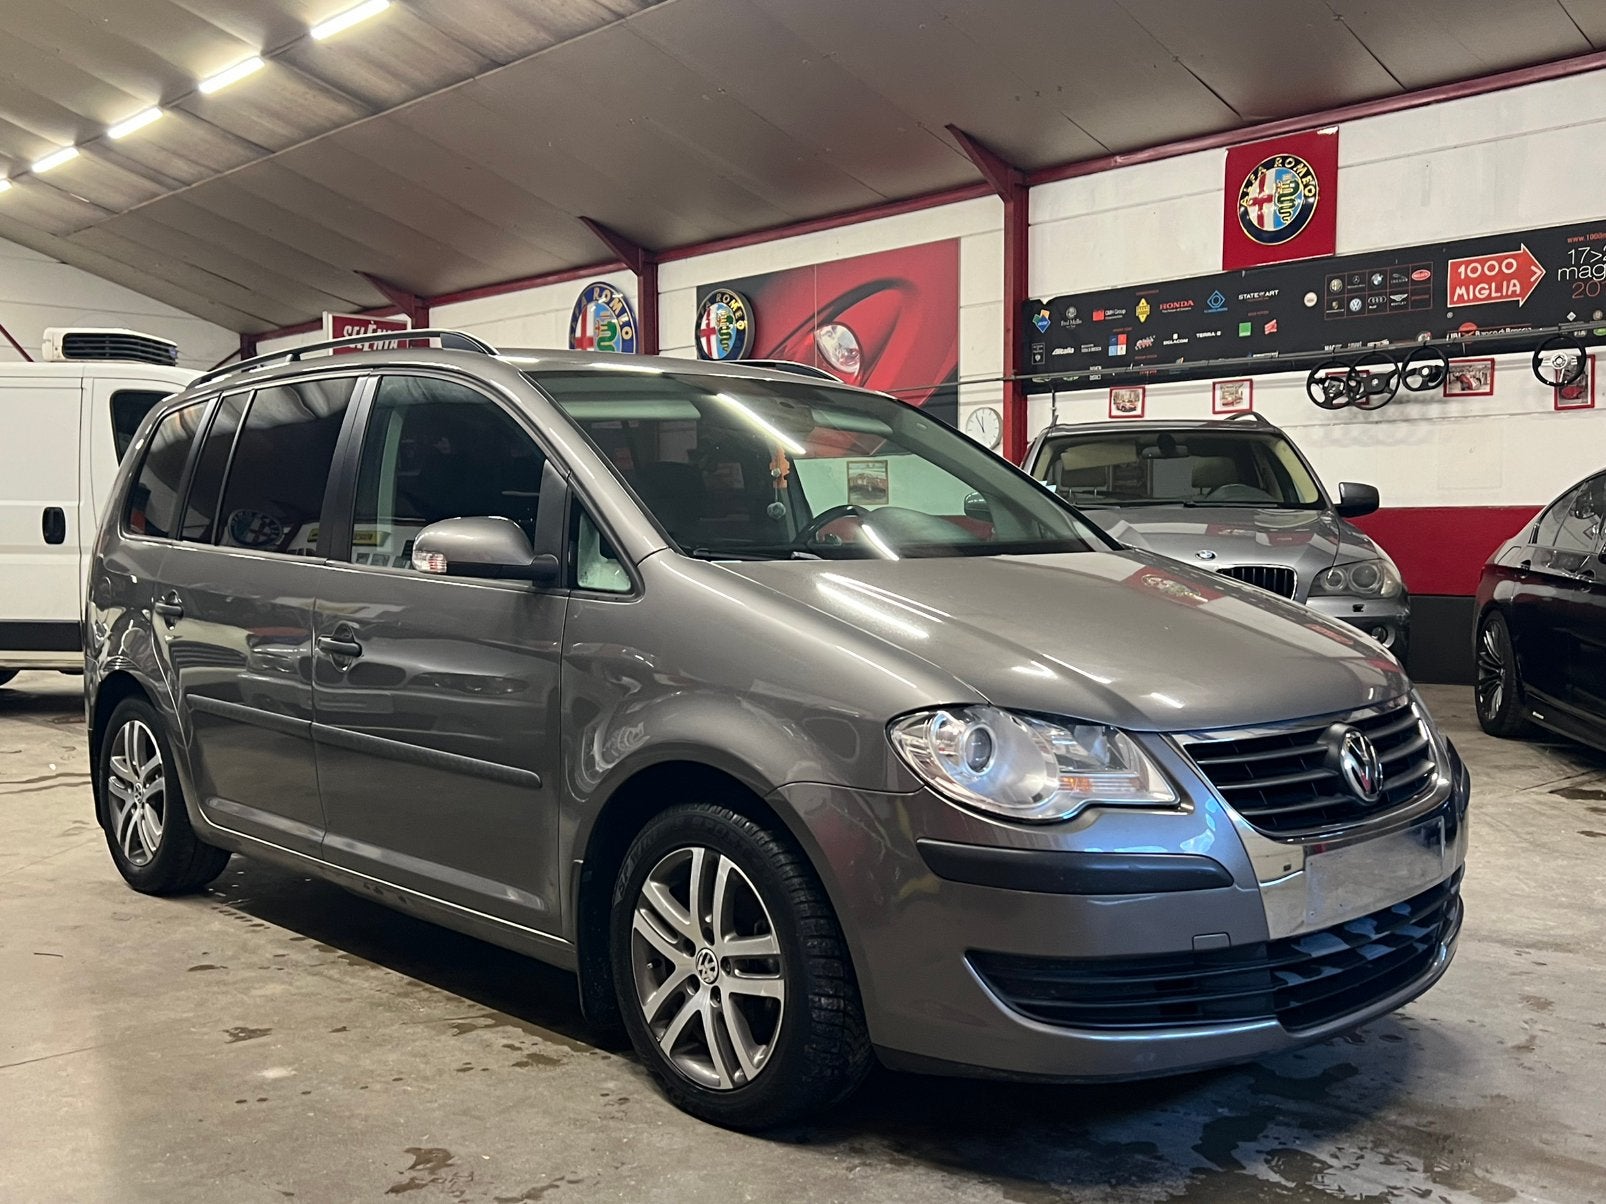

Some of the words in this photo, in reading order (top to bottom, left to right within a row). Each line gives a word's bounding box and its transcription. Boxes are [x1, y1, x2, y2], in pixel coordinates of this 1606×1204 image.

[1273, 157, 1316, 198] ROMEO
[1457, 257, 1518, 279] 1000
[1159, 299, 1194, 310] HONDA
[1453, 278, 1522, 302] MIGLIA
[593, 286, 633, 340] ROMEO
[716, 292, 746, 331] ROMEO
